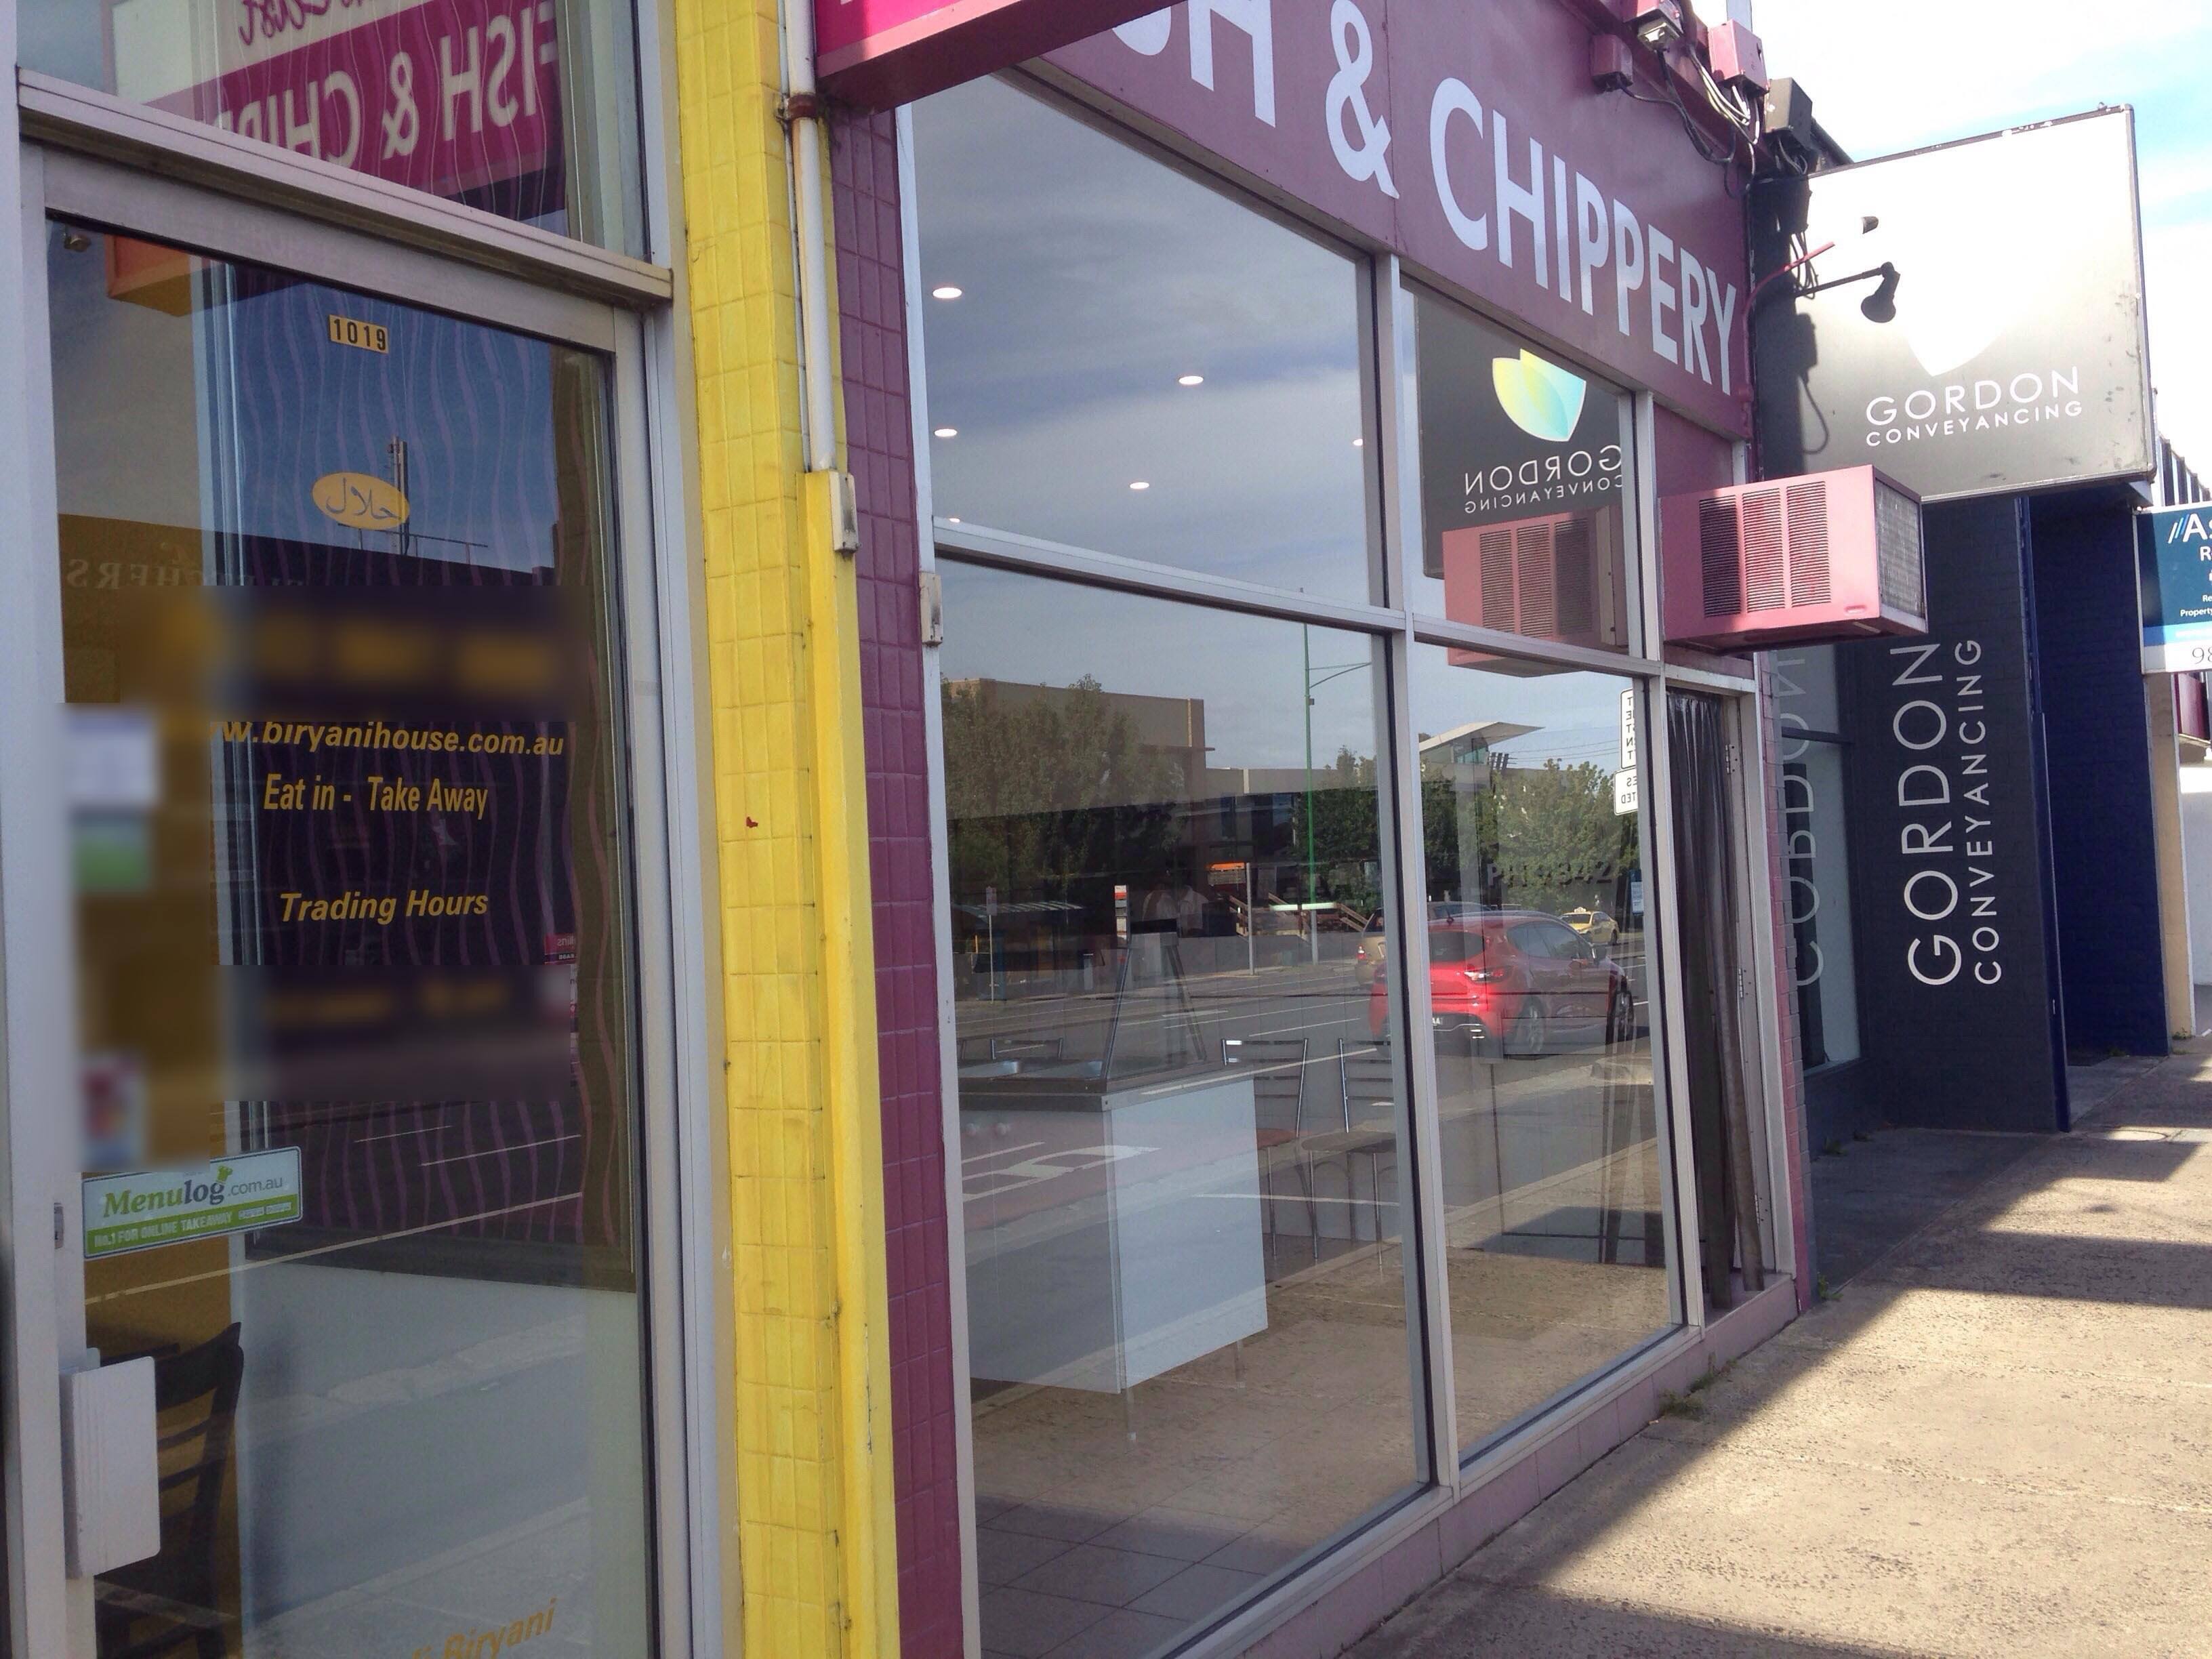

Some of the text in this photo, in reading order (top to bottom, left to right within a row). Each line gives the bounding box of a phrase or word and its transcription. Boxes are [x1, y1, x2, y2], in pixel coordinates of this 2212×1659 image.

[1326, 0, 1399, 199] &
[1430, 77, 1736, 396] CHIPPERY
[334, 319, 386, 350] 1019
[1866, 366, 2078, 426] GORDON
[1866, 401, 2082, 447] CONVEYANCING
[326, 477, 402, 520] حلال
[264, 773, 306, 811] Eat
[312, 775, 335, 811] in
[368, 776, 421, 812] Take
[426, 779, 489, 820] Away
[1889, 643, 1962, 986] GORDON
[1954, 639, 2002, 985] CONVEYANCING
[281, 889, 489, 926] Trading Hours
